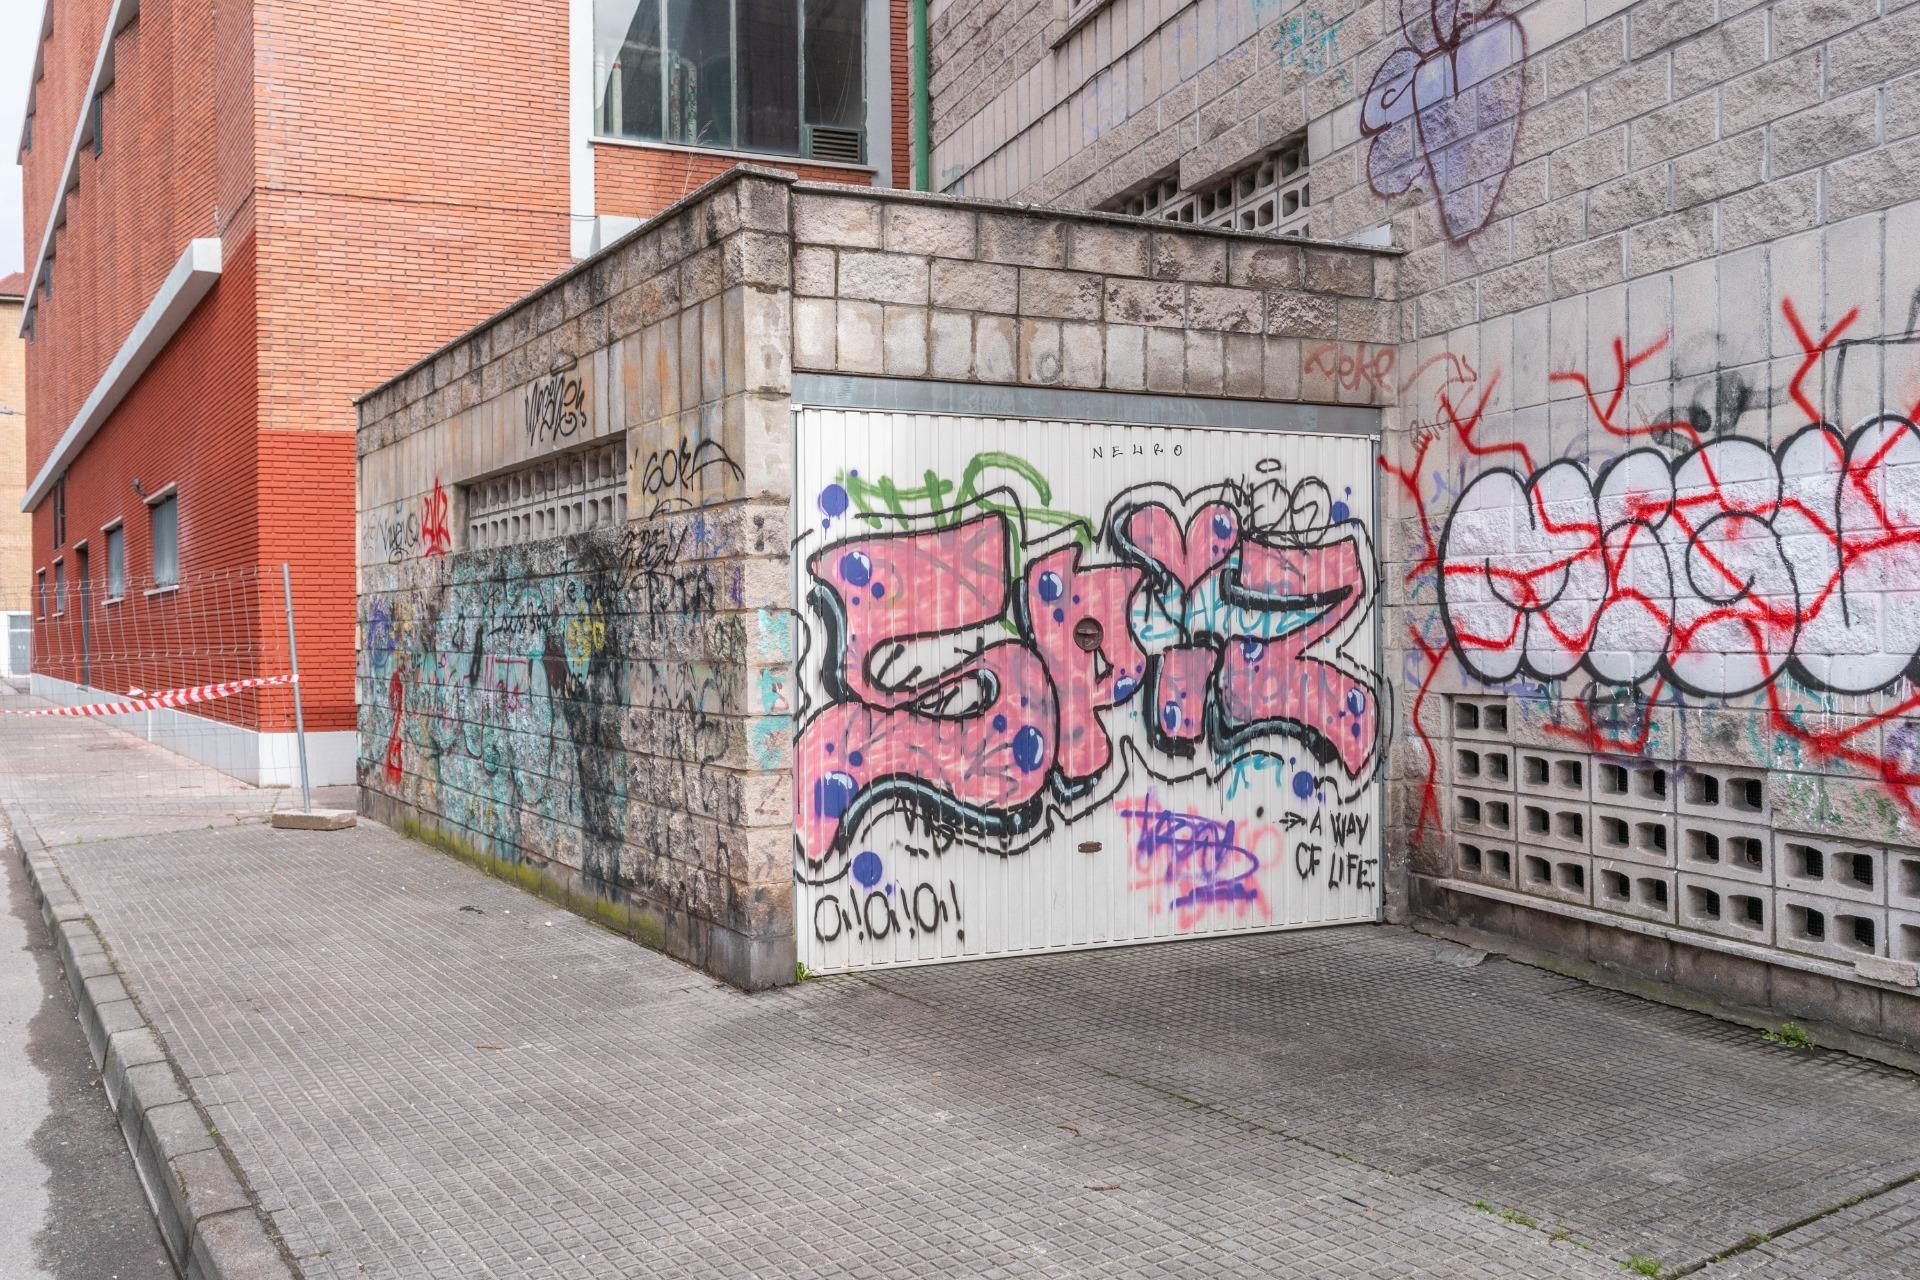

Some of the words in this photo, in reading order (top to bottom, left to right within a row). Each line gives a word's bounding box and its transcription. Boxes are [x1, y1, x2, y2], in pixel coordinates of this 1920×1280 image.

[1309, 806, 1323, 837] A
[1330, 811, 1370, 849] WAY
[1328, 851, 1379, 892] LIFE
